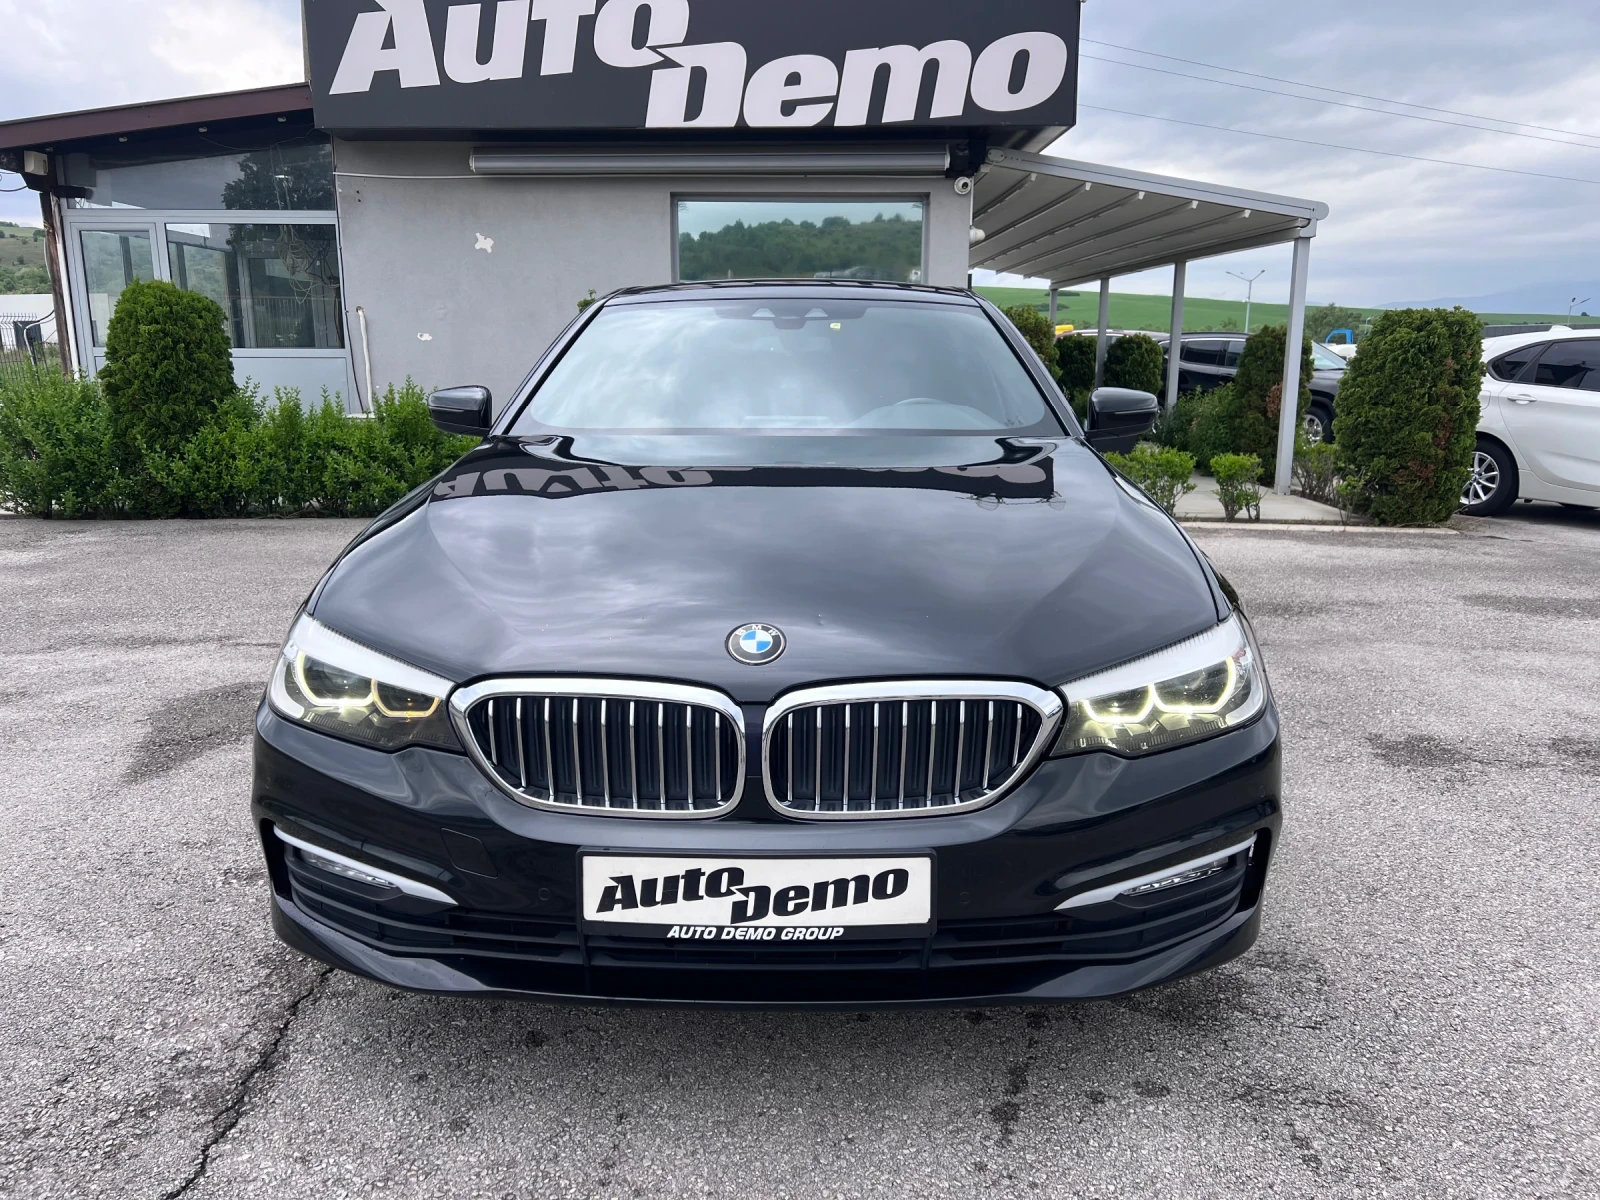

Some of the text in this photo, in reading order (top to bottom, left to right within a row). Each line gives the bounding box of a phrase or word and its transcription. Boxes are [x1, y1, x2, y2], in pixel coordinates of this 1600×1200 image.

[328, 0, 1068, 128] Auto Demo
[735, 624, 779, 636] BMW
[596, 866, 909, 925] Auto Demo
[667, 926, 845, 941] AUTO DEMO GROUP
